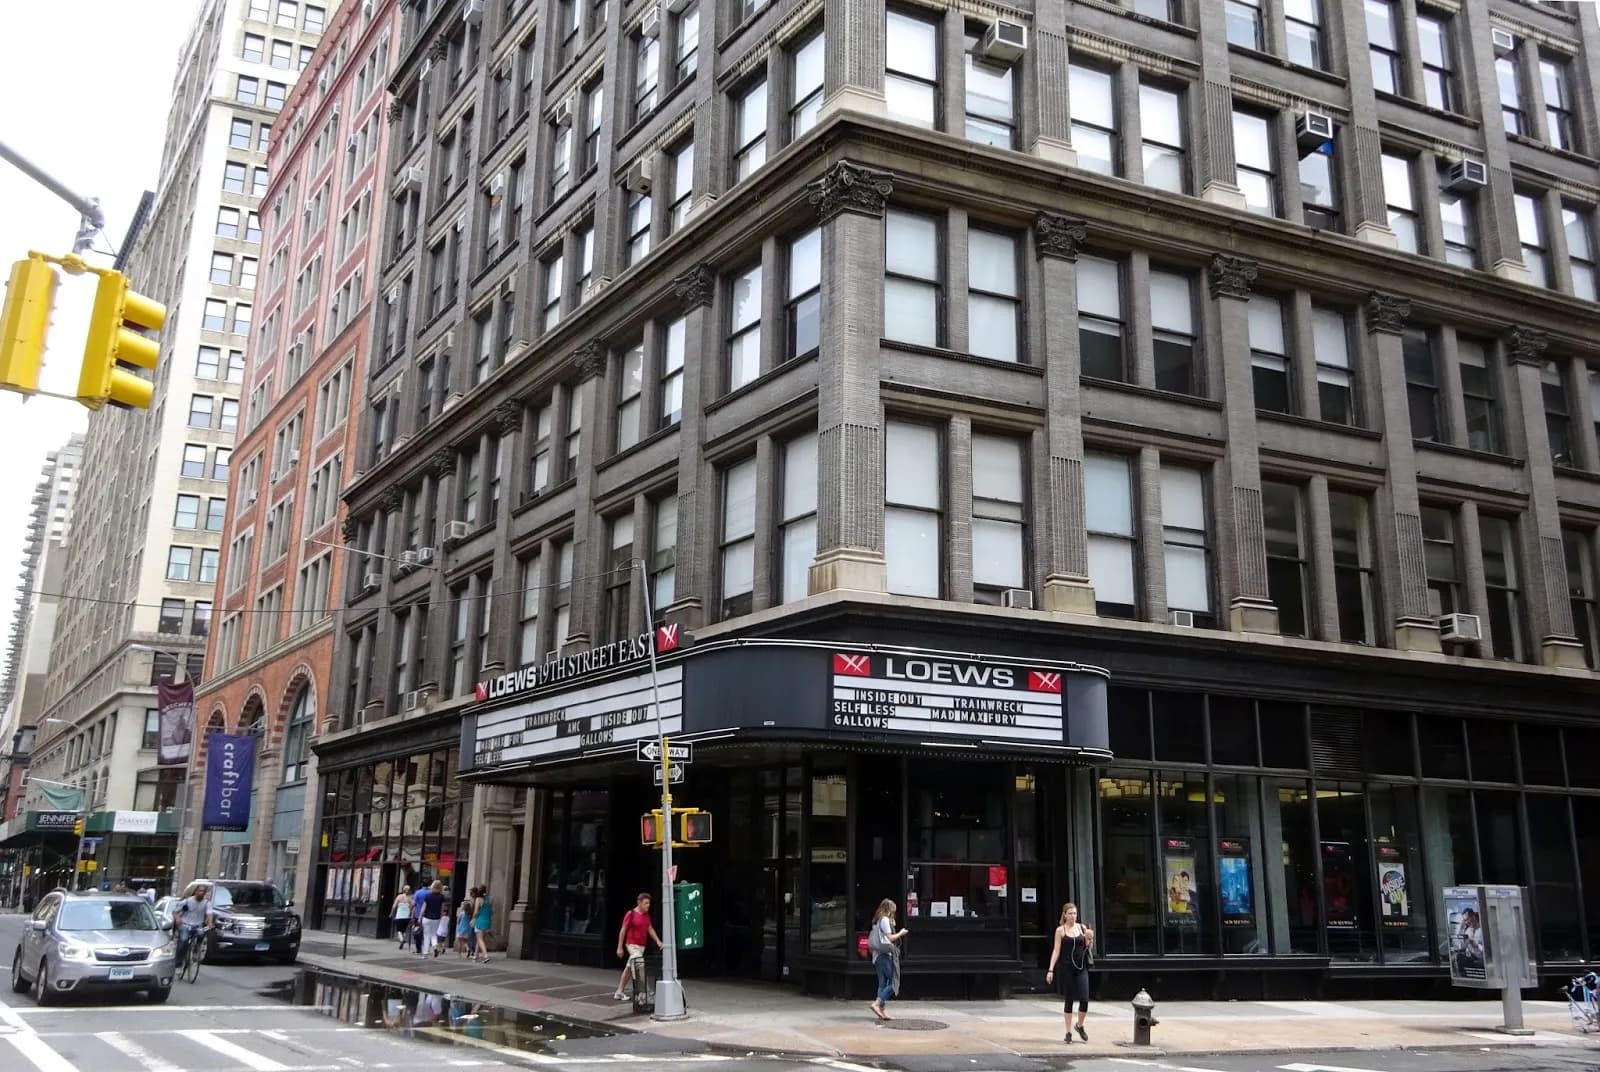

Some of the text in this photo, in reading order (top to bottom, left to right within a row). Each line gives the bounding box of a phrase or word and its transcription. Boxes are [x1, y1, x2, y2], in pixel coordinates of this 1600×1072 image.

[489, 631, 655, 698] LOEWS 19TH STREET EAST
[886, 657, 1015, 687] LOEWS
[854, 689, 922, 705] INSIDE OUT
[953, 698, 1023, 712] TRAINWRECK
[834, 702, 896, 716] SELF LESS
[931, 709, 1017, 725] MAD MAX FURY
[525, 710, 566, 729] TRAINWRECK
[601, 707, 648, 728] INSIDE OUT
[834, 716, 889, 729] GALLOWS
[567, 721, 581, 734] AMC
[580, 730, 614, 746] GALLOWS
[646, 747, 685, 758] ONE WAY
[220, 742, 240, 819] craftbar
